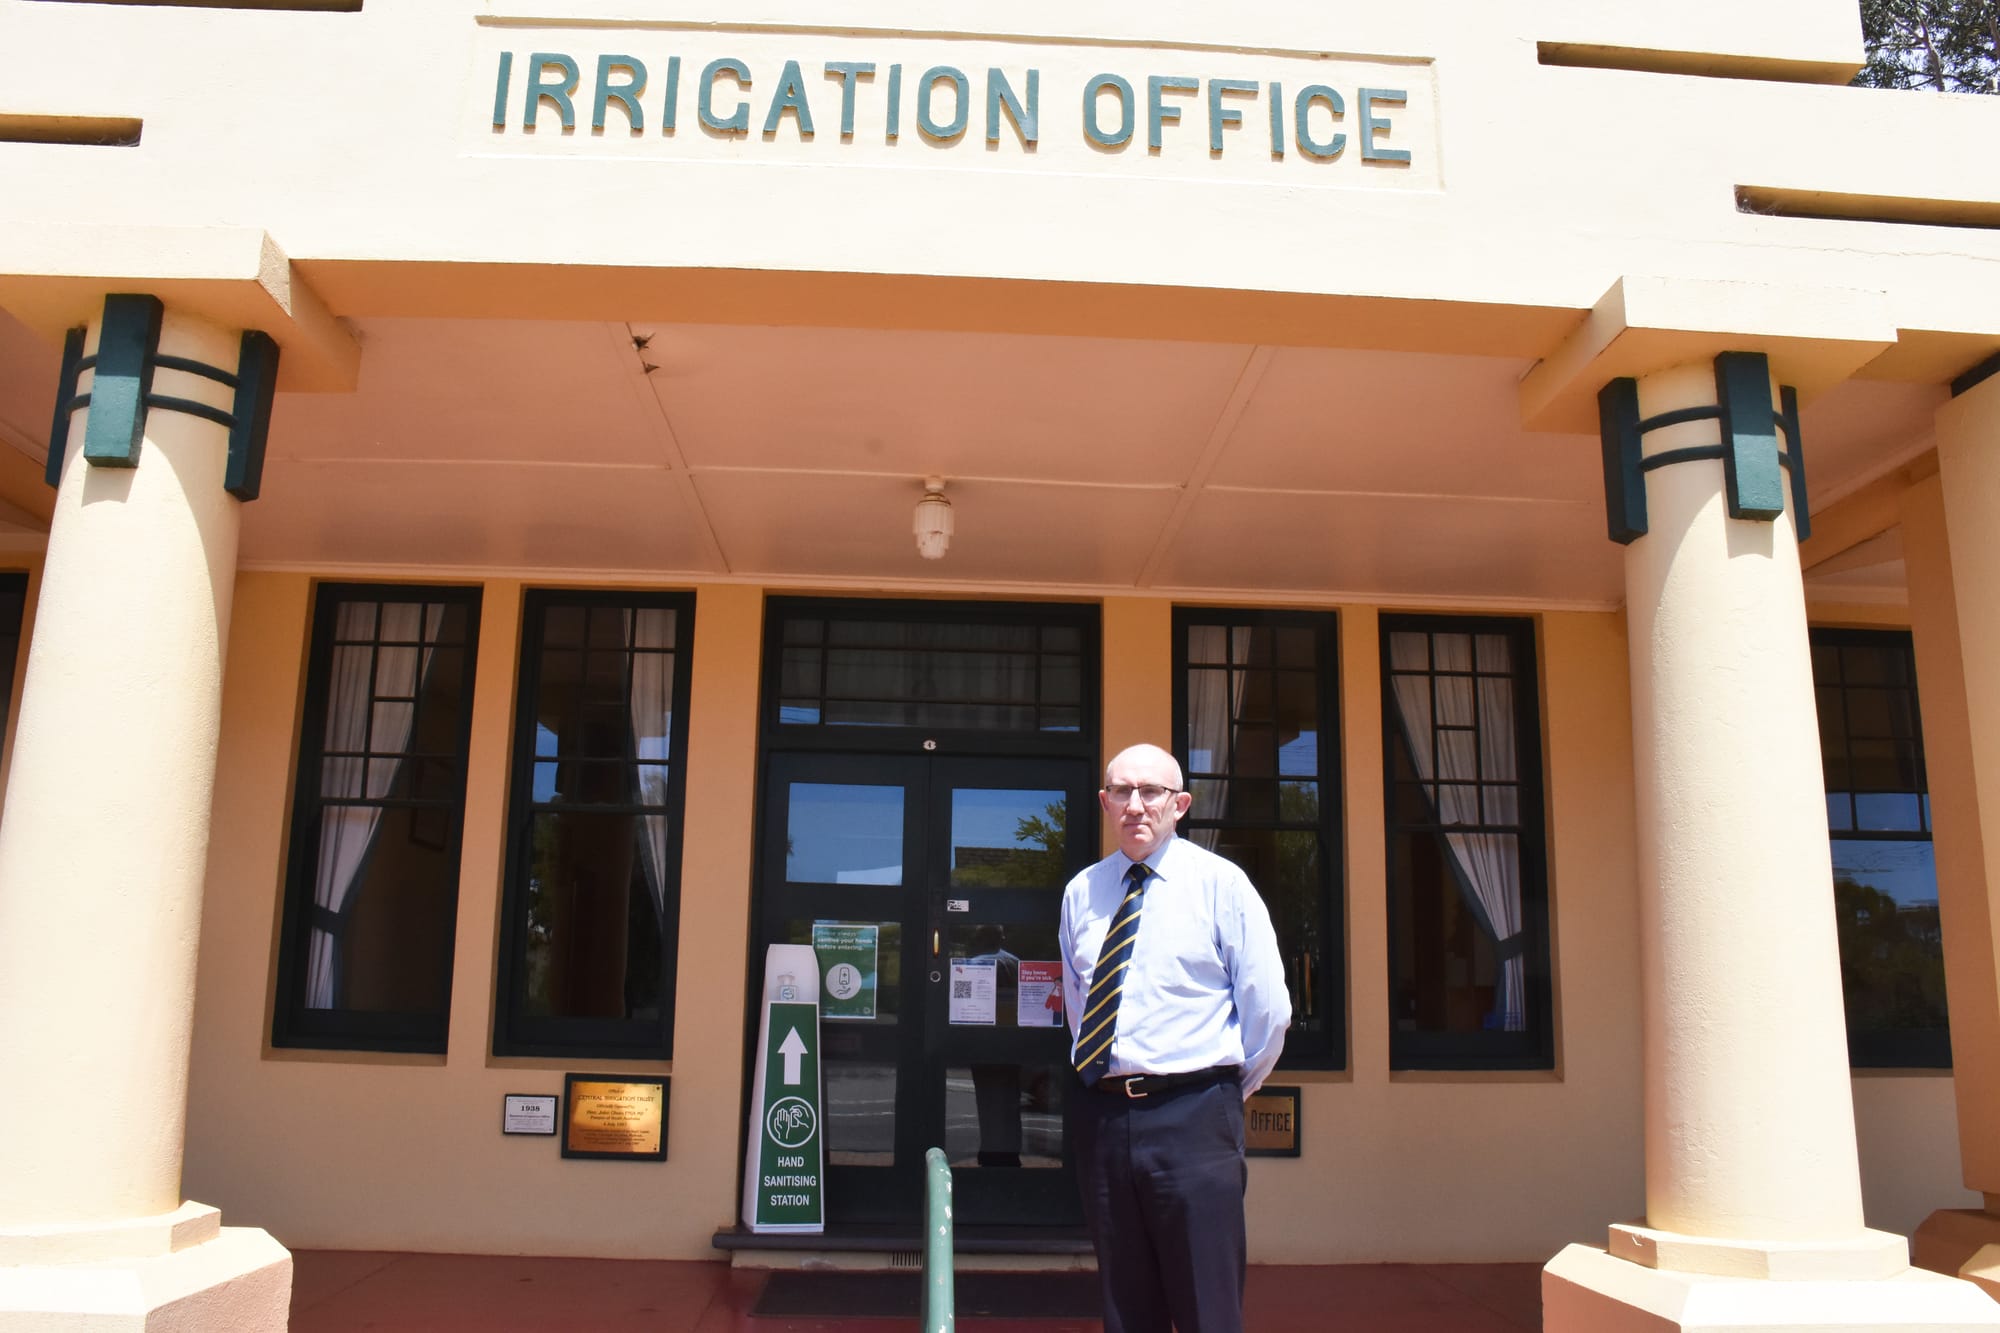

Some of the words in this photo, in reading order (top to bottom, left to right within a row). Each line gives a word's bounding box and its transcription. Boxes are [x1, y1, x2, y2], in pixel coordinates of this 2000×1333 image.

[493, 51, 1040, 142] IRRIGATION
[1083, 73, 1412, 165] OFFICE
[521, 1104, 541, 1112] 1938
[1251, 1109, 1292, 1132] OFFICE
[777, 1156, 805, 1168] HAND
[764, 1175, 817, 1188] SANITISING
[770, 1194, 810, 1207] STATION
